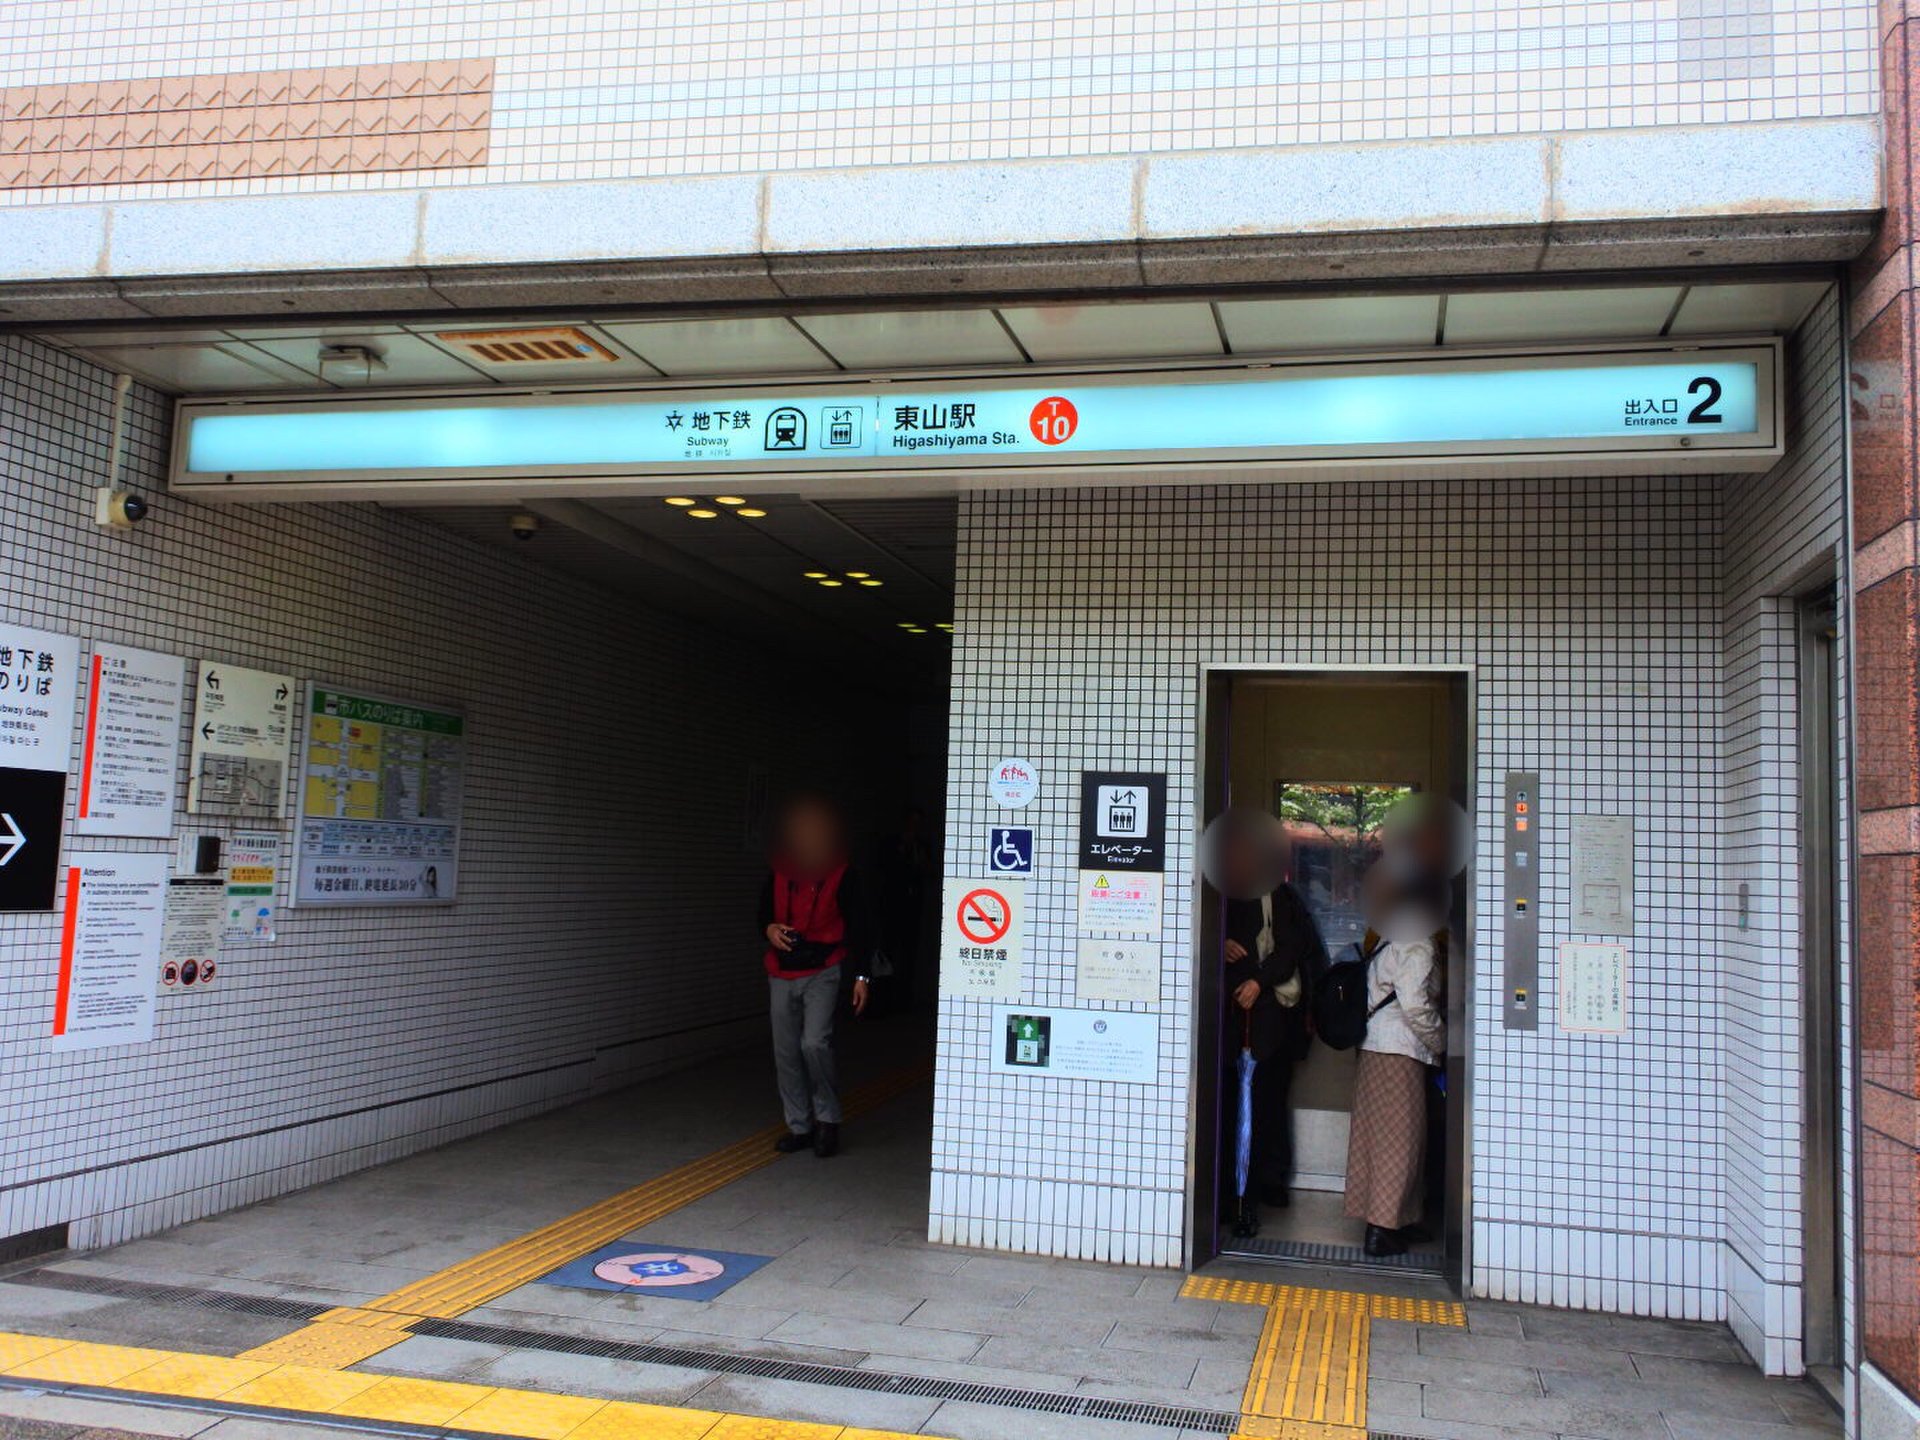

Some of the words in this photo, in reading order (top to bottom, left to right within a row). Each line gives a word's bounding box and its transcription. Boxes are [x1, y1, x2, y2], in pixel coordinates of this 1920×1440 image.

[1624, 398, 1678, 414] 出入口
[1687, 376, 1722, 424] 2
[1048, 401, 1061, 416] T
[691, 410, 751, 431] 地下鉄
[894, 403, 975, 431] 東山駅
[1624, 416, 1677, 426] Entrance
[1036, 415, 1070, 441] 10
[687, 436, 729, 447] Subway
[892, 433, 987, 450] Higashiyama
[992, 431, 1020, 445] Sta.
[0, 703, 23, 716] bway
[1090, 844, 1153, 856] エレベーター
[84, 868, 116, 877] Attention
[959, 947, 1008, 961] 終日禁煙
